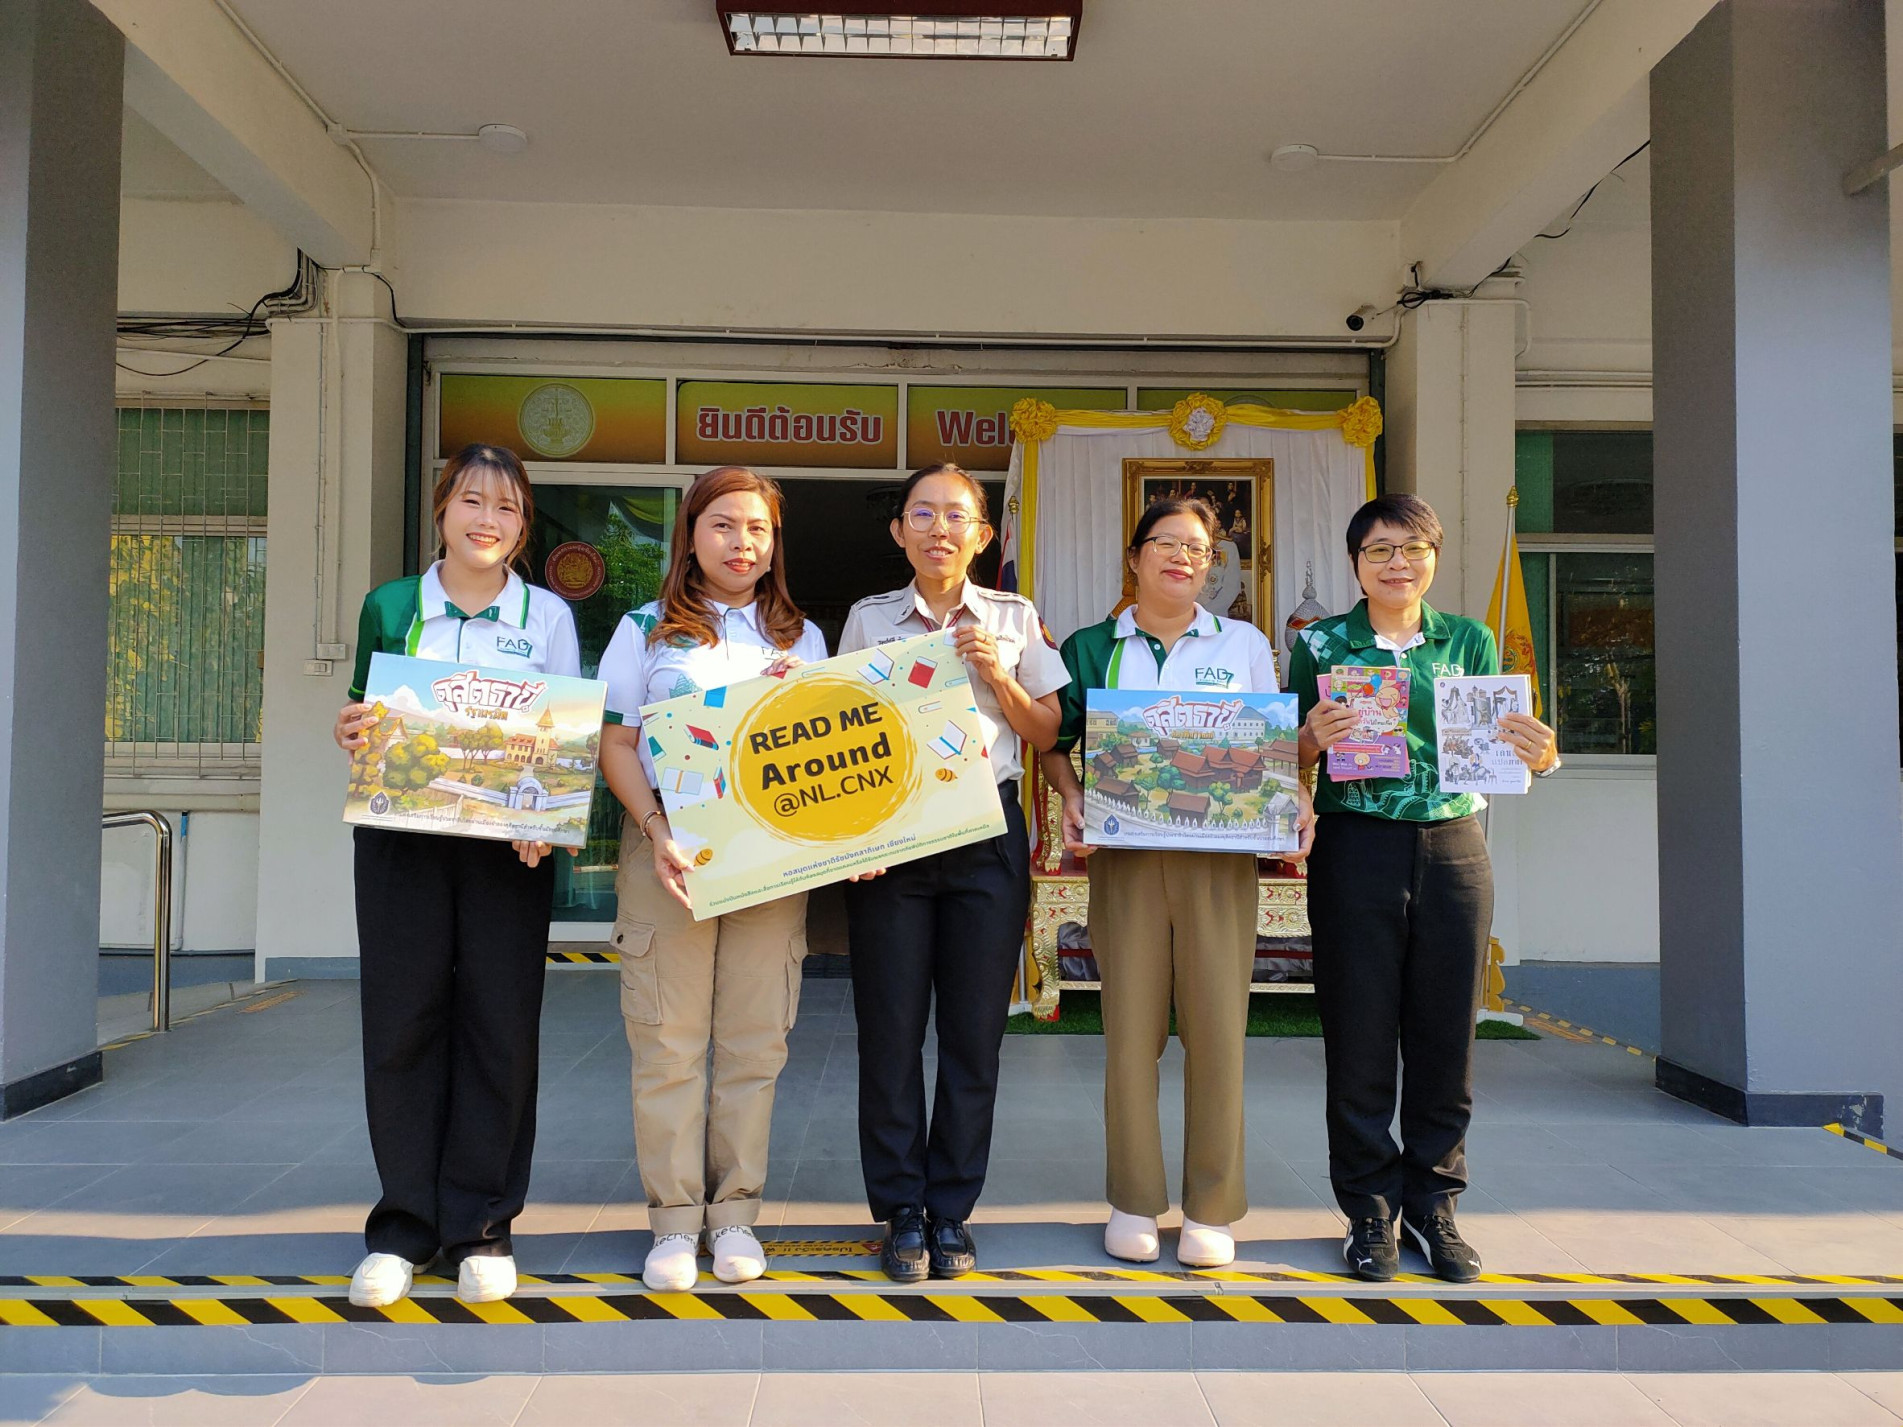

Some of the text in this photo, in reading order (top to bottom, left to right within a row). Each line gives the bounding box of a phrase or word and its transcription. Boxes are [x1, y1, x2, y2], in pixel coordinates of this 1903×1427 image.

[698, 405, 882, 443] ยินดีต้อนรับ
[749, 701, 883, 755] READ ME
[761, 731, 892, 791] Around
[773, 765, 894, 818] @NL.CNX
[886, 833, 917, 850] เชียงใหม่
